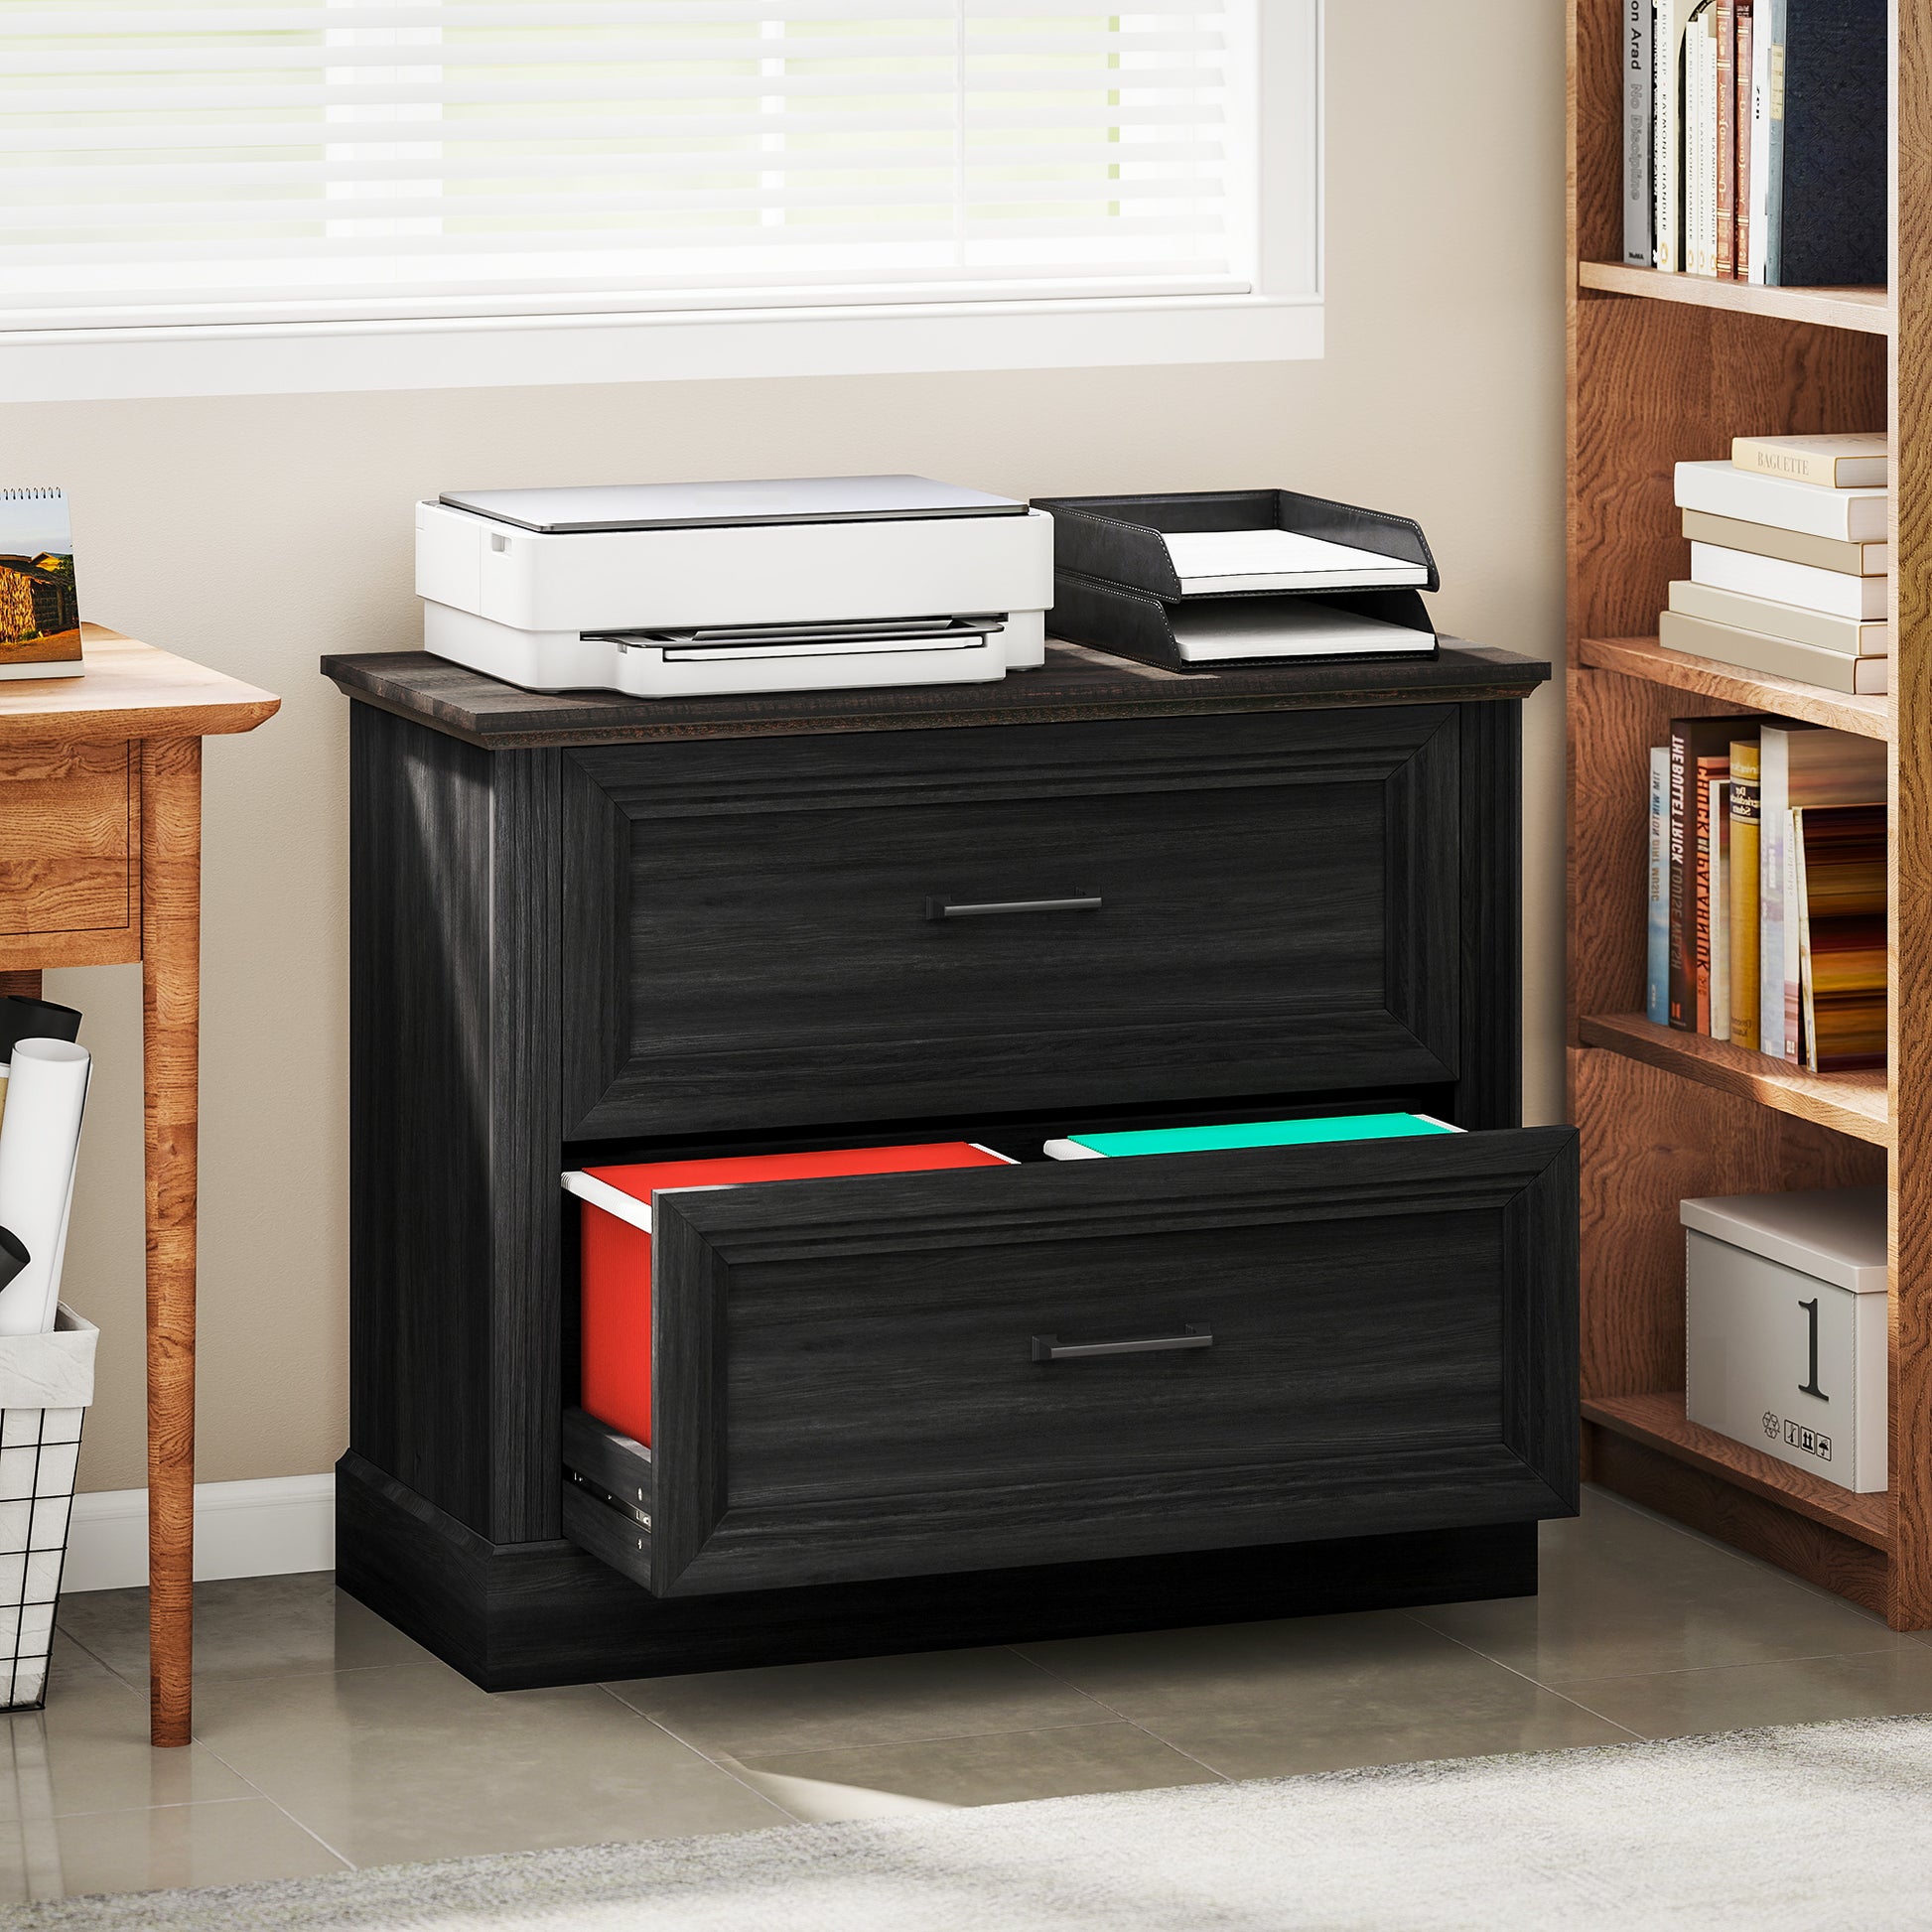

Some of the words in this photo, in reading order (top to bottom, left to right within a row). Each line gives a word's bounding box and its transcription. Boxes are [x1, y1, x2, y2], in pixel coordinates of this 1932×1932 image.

[1631, 29, 1641, 70] Arad
[1631, 83, 1643, 109] No
[1629, 114, 1643, 201] Discipline
[1757, 452, 1809, 476] BAGUETTE
[1798, 1298, 1830, 1402] 1
